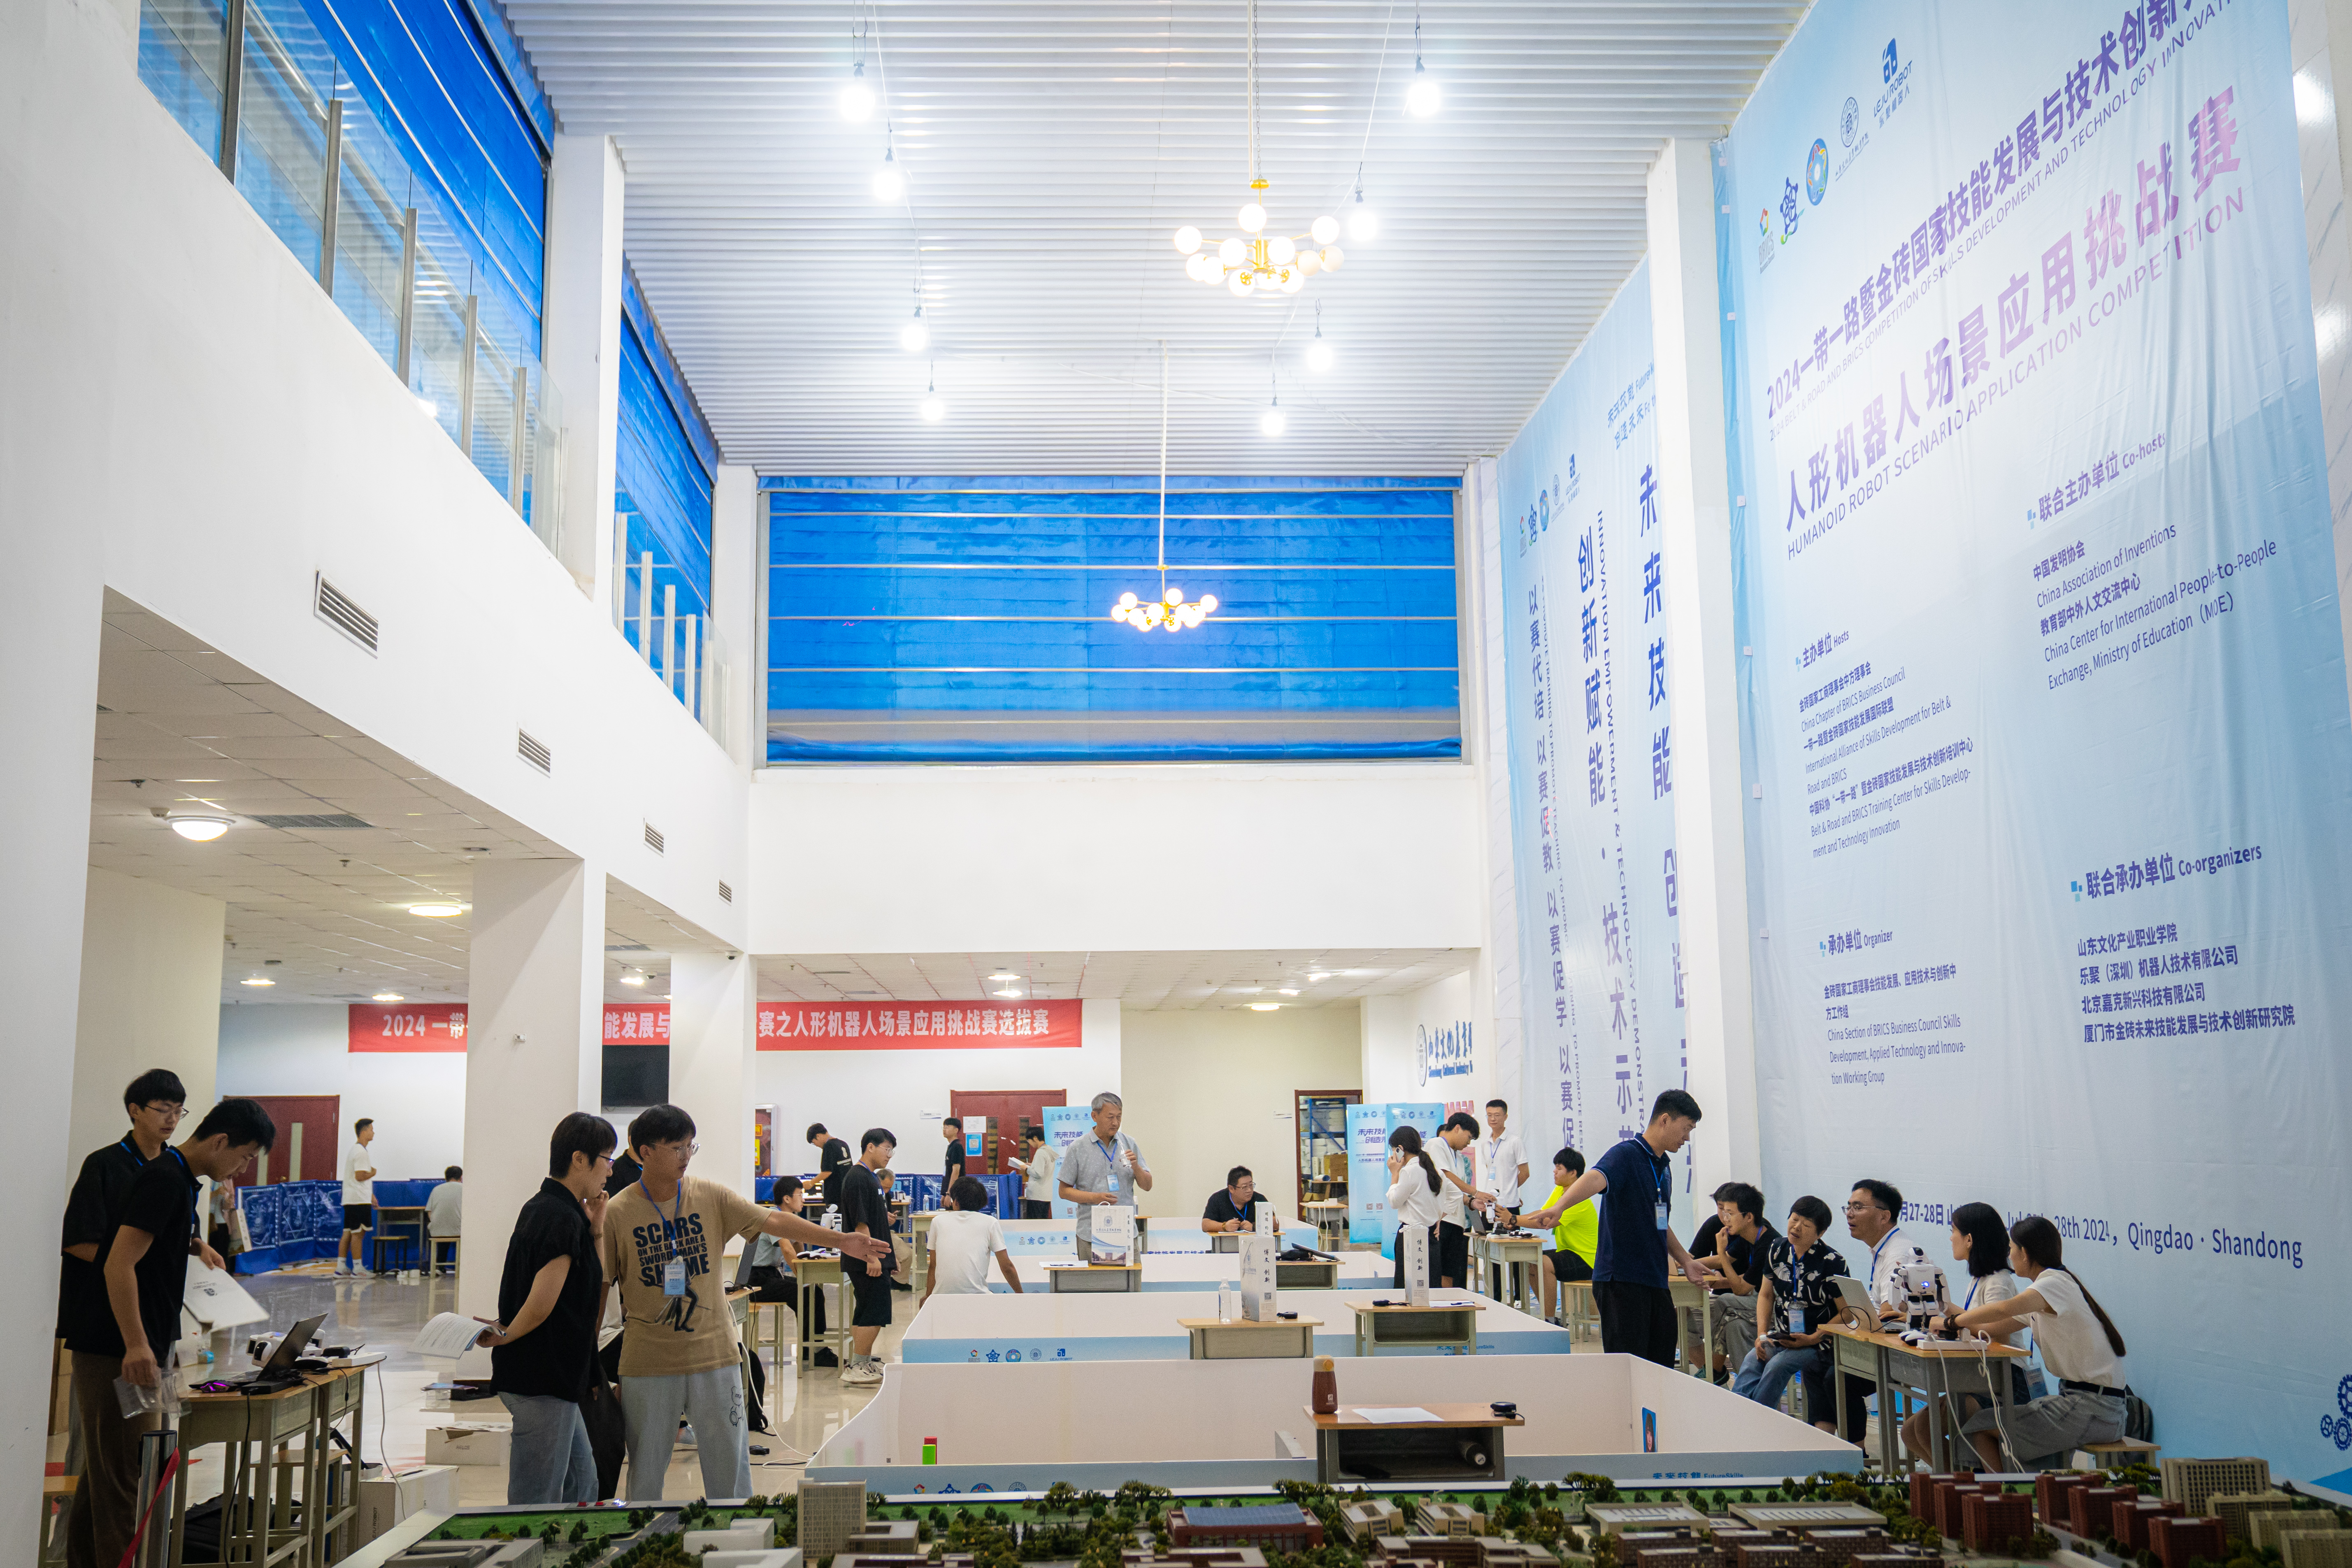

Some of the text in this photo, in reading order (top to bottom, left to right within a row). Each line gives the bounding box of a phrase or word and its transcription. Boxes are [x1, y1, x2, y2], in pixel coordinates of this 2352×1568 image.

[1874, 60, 1913, 118] LEJU ROBOT
[1767, 0, 2191, 420] 2024一带一路暨金砖国家技能发展与技术创新
[1770, 0, 2230, 441] 2024 BELT & ROAD AND BRICS COMPETITION OF SKILLS DEVELOPMENT AND TECHNOLOGY INNOVAT
[1786, 85, 2240, 532] 人形机器人场景应用挑战赛
[1788, 186, 2243, 560] HUMANOID ROBOT SCENARIO APPLICATION COMPETITION
[2038, 432, 2166, 523] 联合主办单位 Co-hosts
[2033, 540, 2085, 582] 中国发明协会
[2037, 525, 2176, 608] China Association of Inventions
[2040, 572, 2141, 637] 教育部中外人文交流中心
[2045, 539, 2277, 662] China Center for International People-to-People
[1640, 463, 1672, 801] 未来技能
[1803, 630, 1849, 668] 主办单位 Hosts
[2048, 663, 2092, 690] Exchange,
[2093, 641, 2129, 671] Ministry
[2132, 634, 2141, 654] of
[2143, 614, 2193, 648] Education
[1799, 661, 1871, 713] 金砖国家工商理事会中方理事会
[1801, 667, 1906, 732] China Chapter of BRICS Business Council
[1803, 696, 1894, 751] 一带一路暨金砖国家技能发展国际联盟
[1806, 695, 1951, 774] International Alliance of Skills Development for Belt &
[1807, 768, 1847, 794] Road and BRICS
[1811, 768, 1971, 837] Belt & Road and BRICS Training Center for Skills Develop-
[1598, 510, 1645, 1134] INNOVATION EMPOWERMENT & TECHNOLOGY DEMONSTRA
[1813, 818, 1900, 858] ment and Technology Innovation
[1529, 584, 1544, 721] 以赛代培
[1547, 888, 1567, 1028] 以赛促学
[1559, 1044, 1575, 1148] 以赛促
[2085, 845, 2262, 899] 联合承办单位 Co-organizers
[1828, 928, 1892, 956] 承办单位 Organizer
[2077, 922, 2178, 957] 山东文化产业职业学院
[1824, 963, 1956, 999] 金砖国家工商理事会技能发展、应用技术与创新中
[2081, 982, 2206, 1014] 北京嘉克新兴科技有限公司
[382, 1014, 425, 1037] 2024
[432, 1012, 468, 1040] 一带
[758, 1008, 1049, 1038] 赛之人形机器人场景应用挑战赛选拔赛
[1826, 1004, 1849, 1020] 方工作组
[1828, 1014, 1961, 1041] China Section of BRICS Business Council Skills
[2084, 1004, 2296, 1043] 厦门市金砖未来技能发展与技术创新研究院
[1829, 1040, 1966, 1064] Development, Applied Technology and Innova-
[1831, 1071, 1885, 1086] tion Working Group
[633, 1213, 703, 1247] SCARS
[638, 1248, 647, 1257] ON
[648, 1244, 663, 1254] THE
[686, 1236, 699, 1245] ARE
[2128, 1222, 2194, 1254] Qingdao
[2212, 1228, 2303, 1269] Shandong
[641, 1253, 710, 1284] SHME
